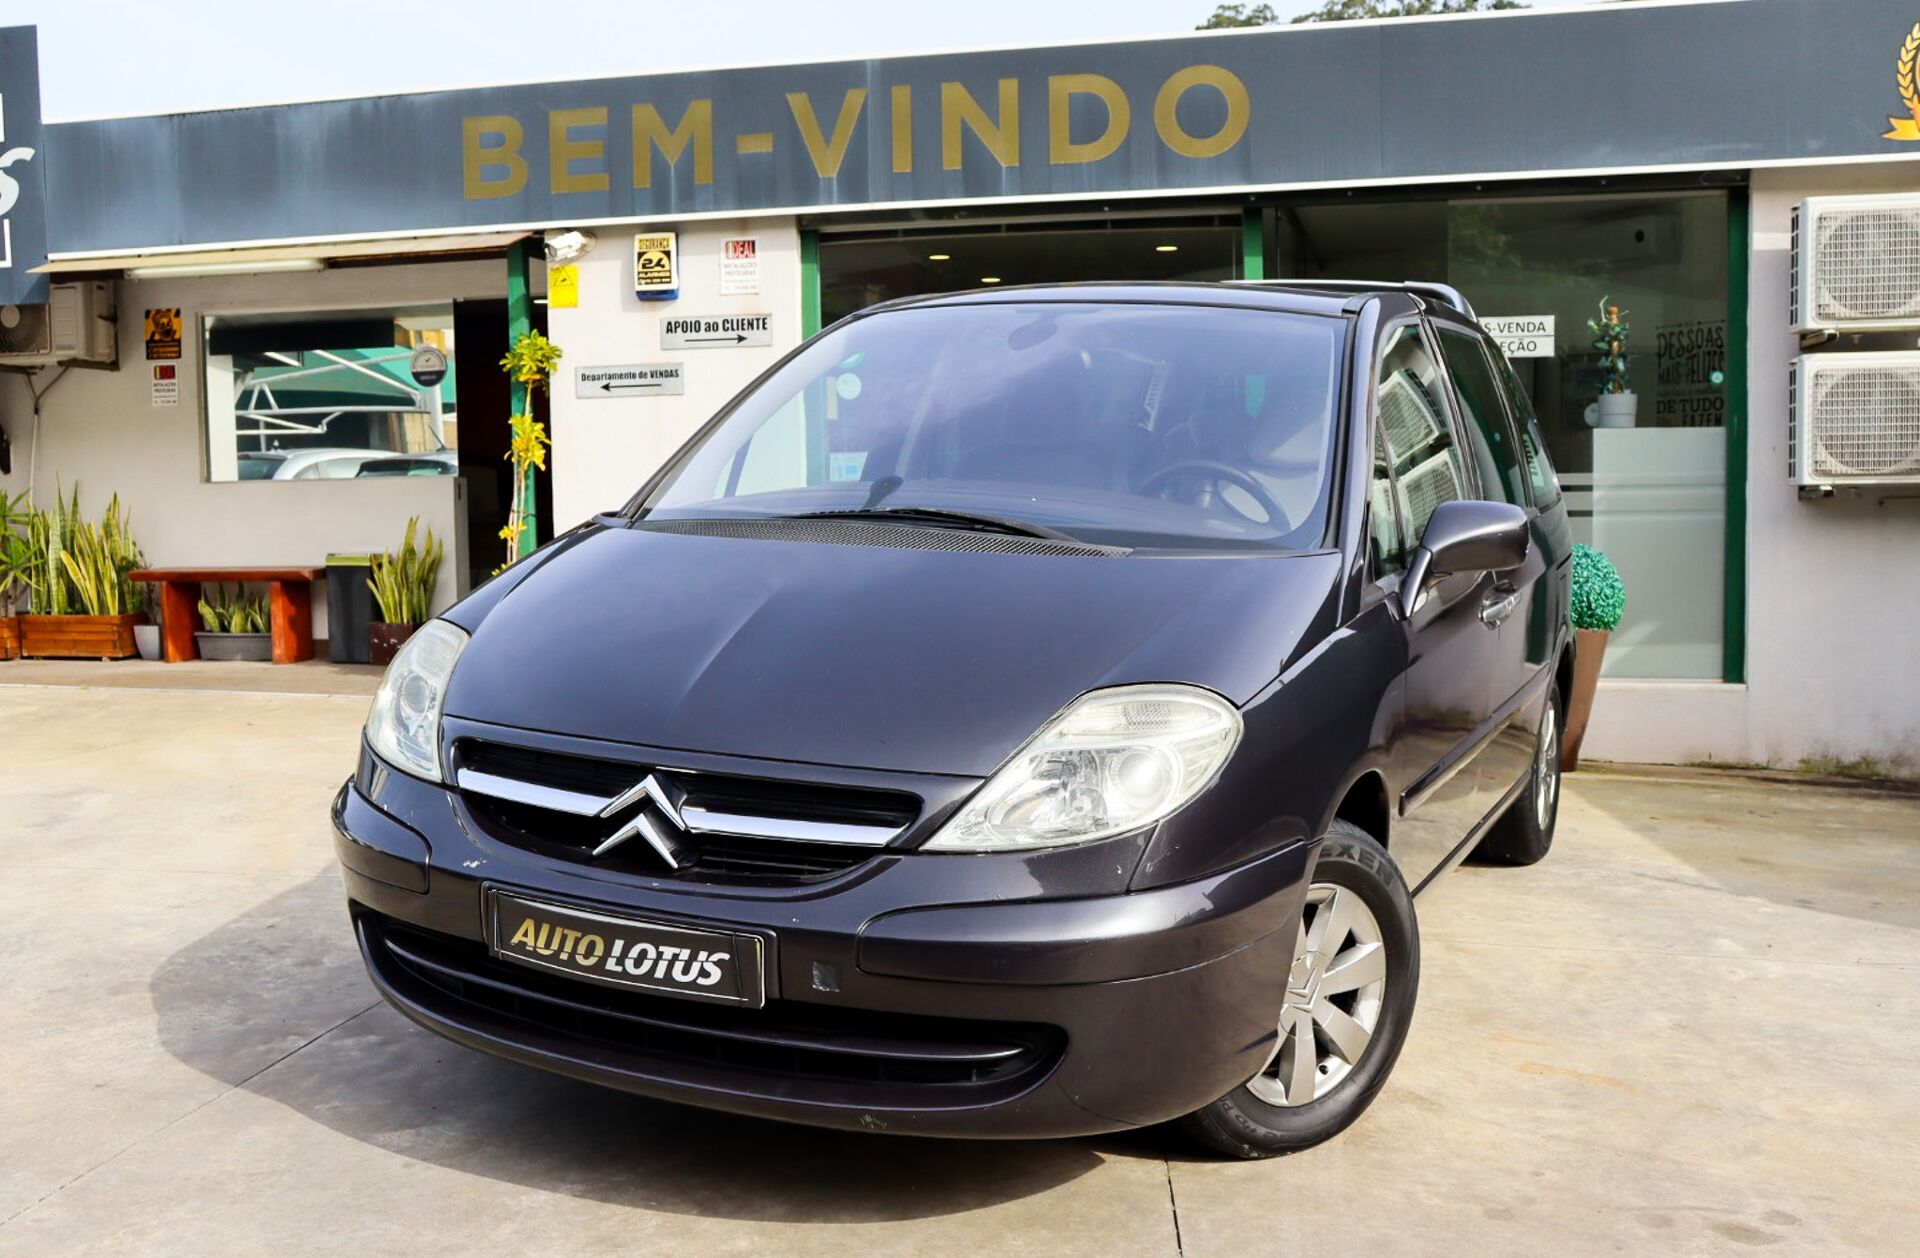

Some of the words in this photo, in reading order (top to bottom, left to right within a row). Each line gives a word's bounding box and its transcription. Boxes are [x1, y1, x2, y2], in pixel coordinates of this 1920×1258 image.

[463, 64, 1251, 200] BEM-VINDO
[641, 258, 666, 270] 24
[666, 319, 701, 334] APOIO
[704, 322, 719, 333] ao
[722, 317, 768, 333] CLIENTE
[1484, 321, 1546, 334] S-VENDA
[1500, 338, 1537, 355] EÇÃO
[1656, 326, 1724, 368] PESSOAS
[581, 371, 637, 382] Departamento
[638, 370, 648, 380] de
[650, 368, 679, 379] VENDAS
[1656, 400, 1676, 414] DE
[1679, 396, 1724, 413] TUDO
[510, 918, 605, 966] AUTO
[605, 938, 730, 986] LOTUS
